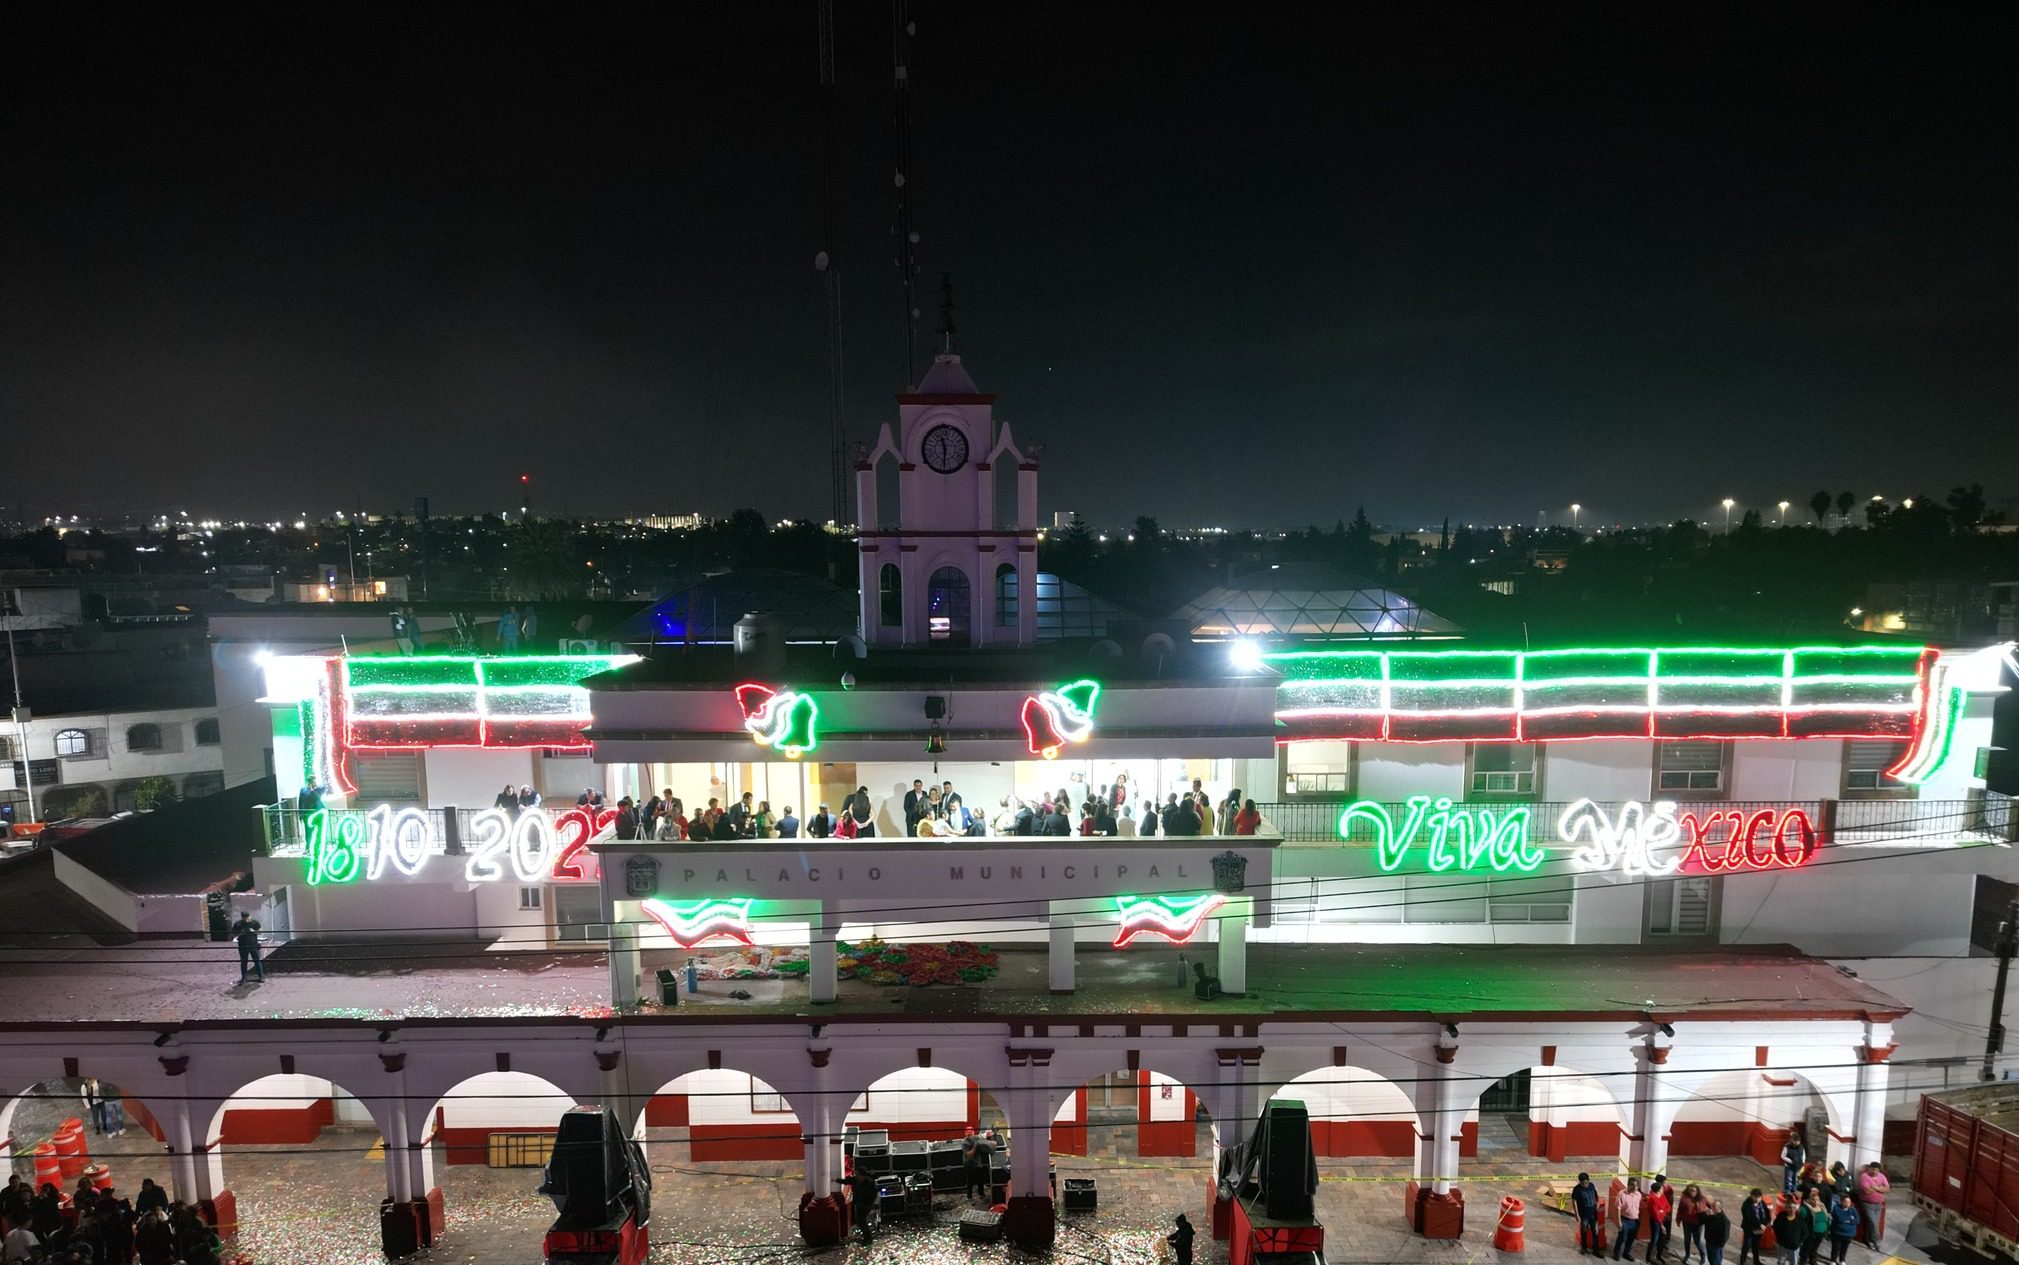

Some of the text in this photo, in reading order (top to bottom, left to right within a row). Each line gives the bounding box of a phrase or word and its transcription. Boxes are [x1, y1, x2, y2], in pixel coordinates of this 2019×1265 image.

[305, 803, 430, 886] 1810
[1339, 796, 1544, 872] Viva
[950, 865, 1188, 880] MUNICIPAL
